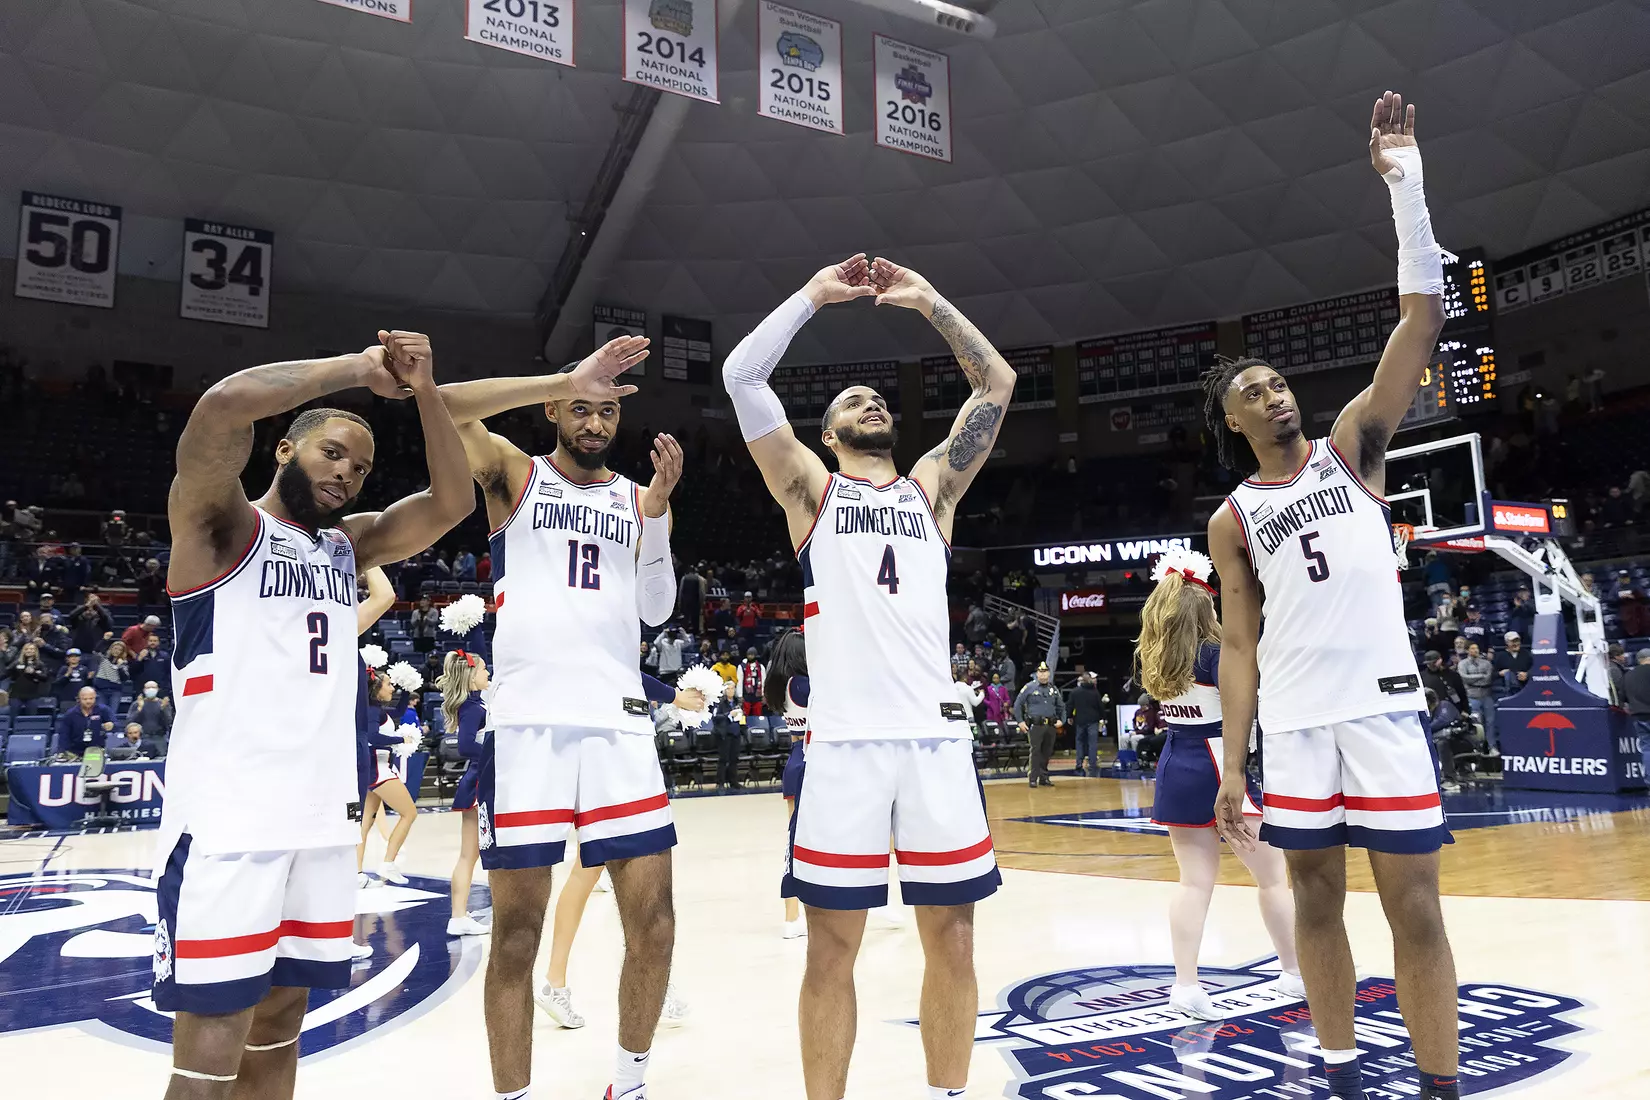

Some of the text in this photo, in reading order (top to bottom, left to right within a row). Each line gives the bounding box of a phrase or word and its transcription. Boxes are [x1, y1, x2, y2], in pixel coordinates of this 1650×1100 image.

[483, 0, 559, 28] 2013
[486, 16, 557, 43] NATIONAL
[480, 29, 562, 58] CHAMPIONS
[637, 31, 706, 68] 2014
[636, 70, 708, 96] CHAMPIONS
[641, 58, 703, 82] NATIONAL
[770, 68, 831, 101] 2015
[769, 105, 835, 129] CHAMPIONS
[774, 94, 830, 115] NATIONAL
[886, 100, 942, 132] 2016
[884, 135, 944, 158] CHAMPIONS
[889, 124, 939, 144] NATIONAL
[32, 195, 80, 211] REBECCA
[26, 210, 111, 273] 50
[203, 223, 223, 234] RAY
[189, 238, 264, 297] 34
[1504, 288, 1520, 303] C
[1570, 263, 1596, 284] 22
[1607, 250, 1636, 272] 25
[1290, 291, 1390, 316] CHAMPIONSHIP
[828, 362, 897, 373] CONFERENCE
[533, 502, 633, 548] CONNECTICUT
[835, 504, 928, 542] CONNECTICUT
[1256, 485, 1354, 555] CONNECTICUT
[568, 539, 600, 590] 12
[1034, 543, 1112, 566] UCONN
[1299, 531, 1330, 583] 5
[877, 544, 899, 594] 4
[306, 612, 329, 675] 2
[1501, 755, 1608, 776] TRAVELERS
[1169, 1022, 1256, 1046] 2011
[1046, 1040, 1147, 1063] 2014
